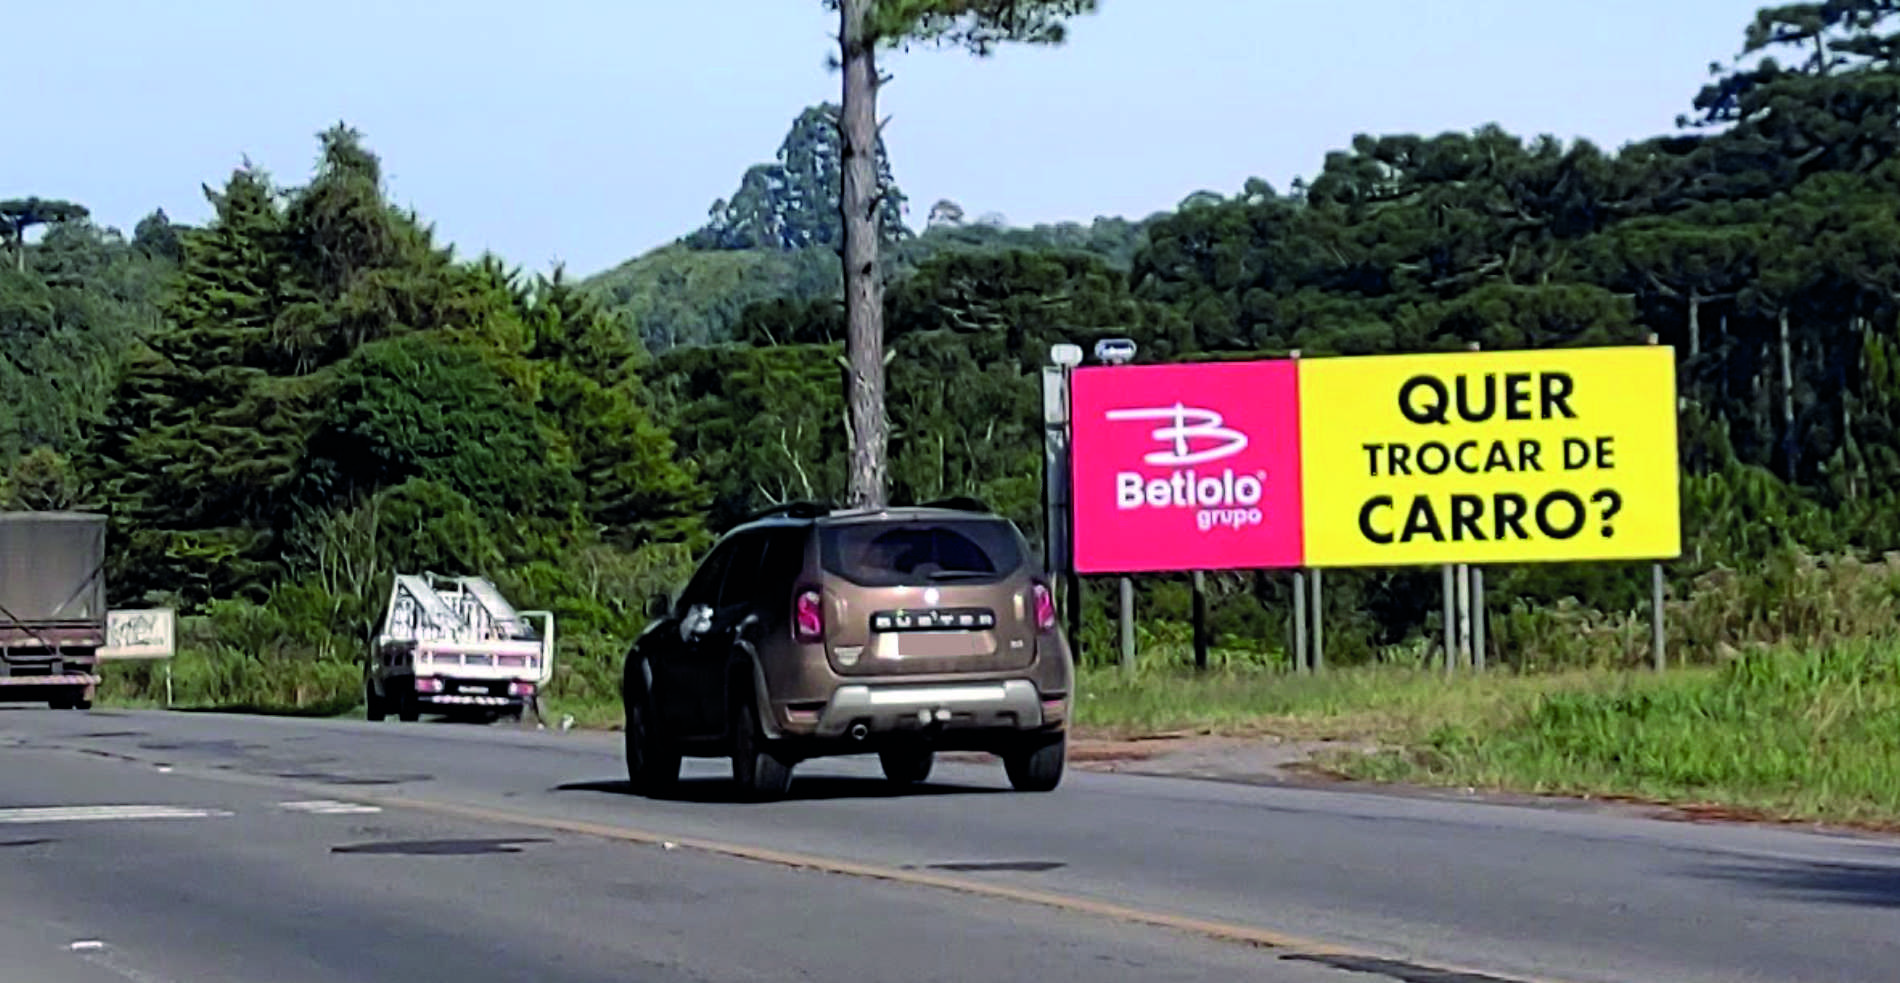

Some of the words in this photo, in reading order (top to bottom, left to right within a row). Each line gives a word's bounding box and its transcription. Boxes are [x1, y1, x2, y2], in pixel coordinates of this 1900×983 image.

[1398, 372, 1576, 425] QUER
[1363, 439, 1543, 477] TROCAR
[1564, 436, 1615, 470] DE
[1197, 507, 1263, 532] grupo
[1358, 489, 1623, 545] CARRO?
